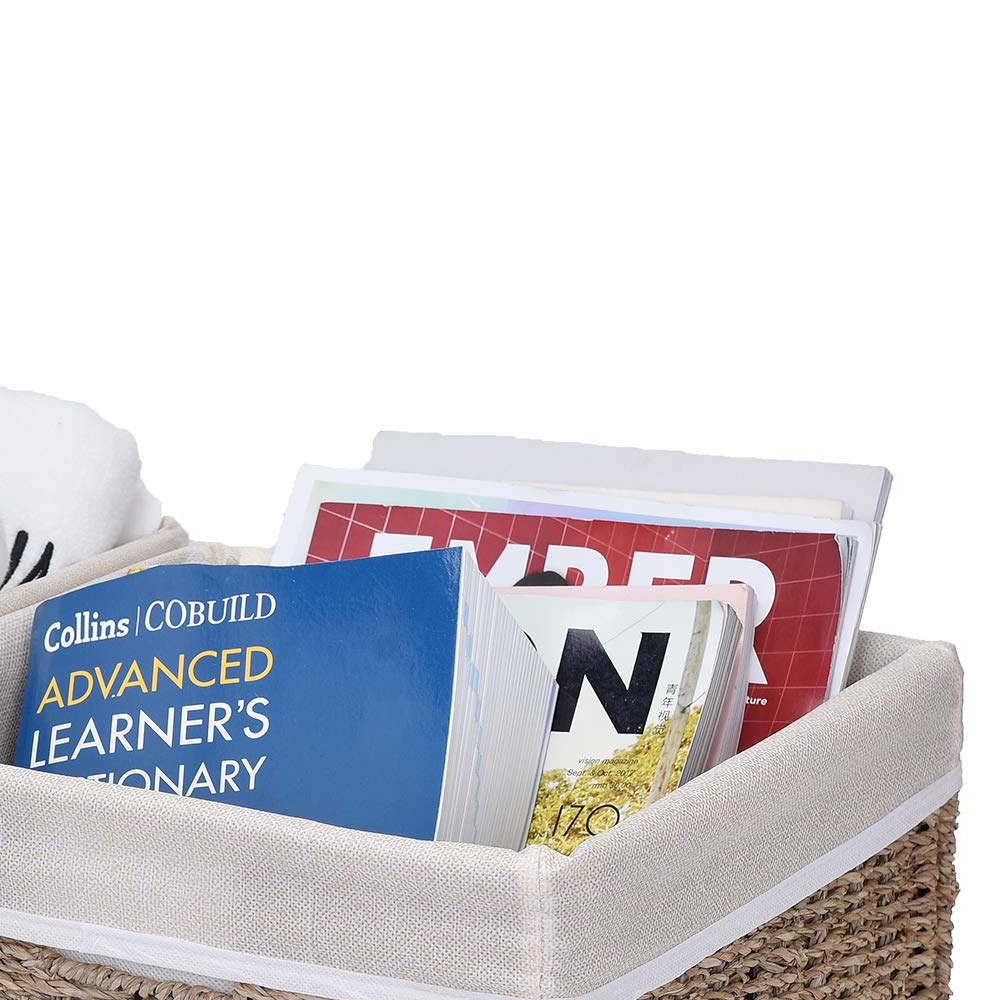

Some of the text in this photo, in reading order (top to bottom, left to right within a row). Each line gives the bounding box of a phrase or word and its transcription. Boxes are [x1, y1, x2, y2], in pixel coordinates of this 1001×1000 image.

[44, 592, 277, 652] Collins COBUILD
[36, 645, 274, 714] ADVANCED
[30, 697, 271, 769] LEARNER'S
[578, 757, 639, 767] vision magazine
